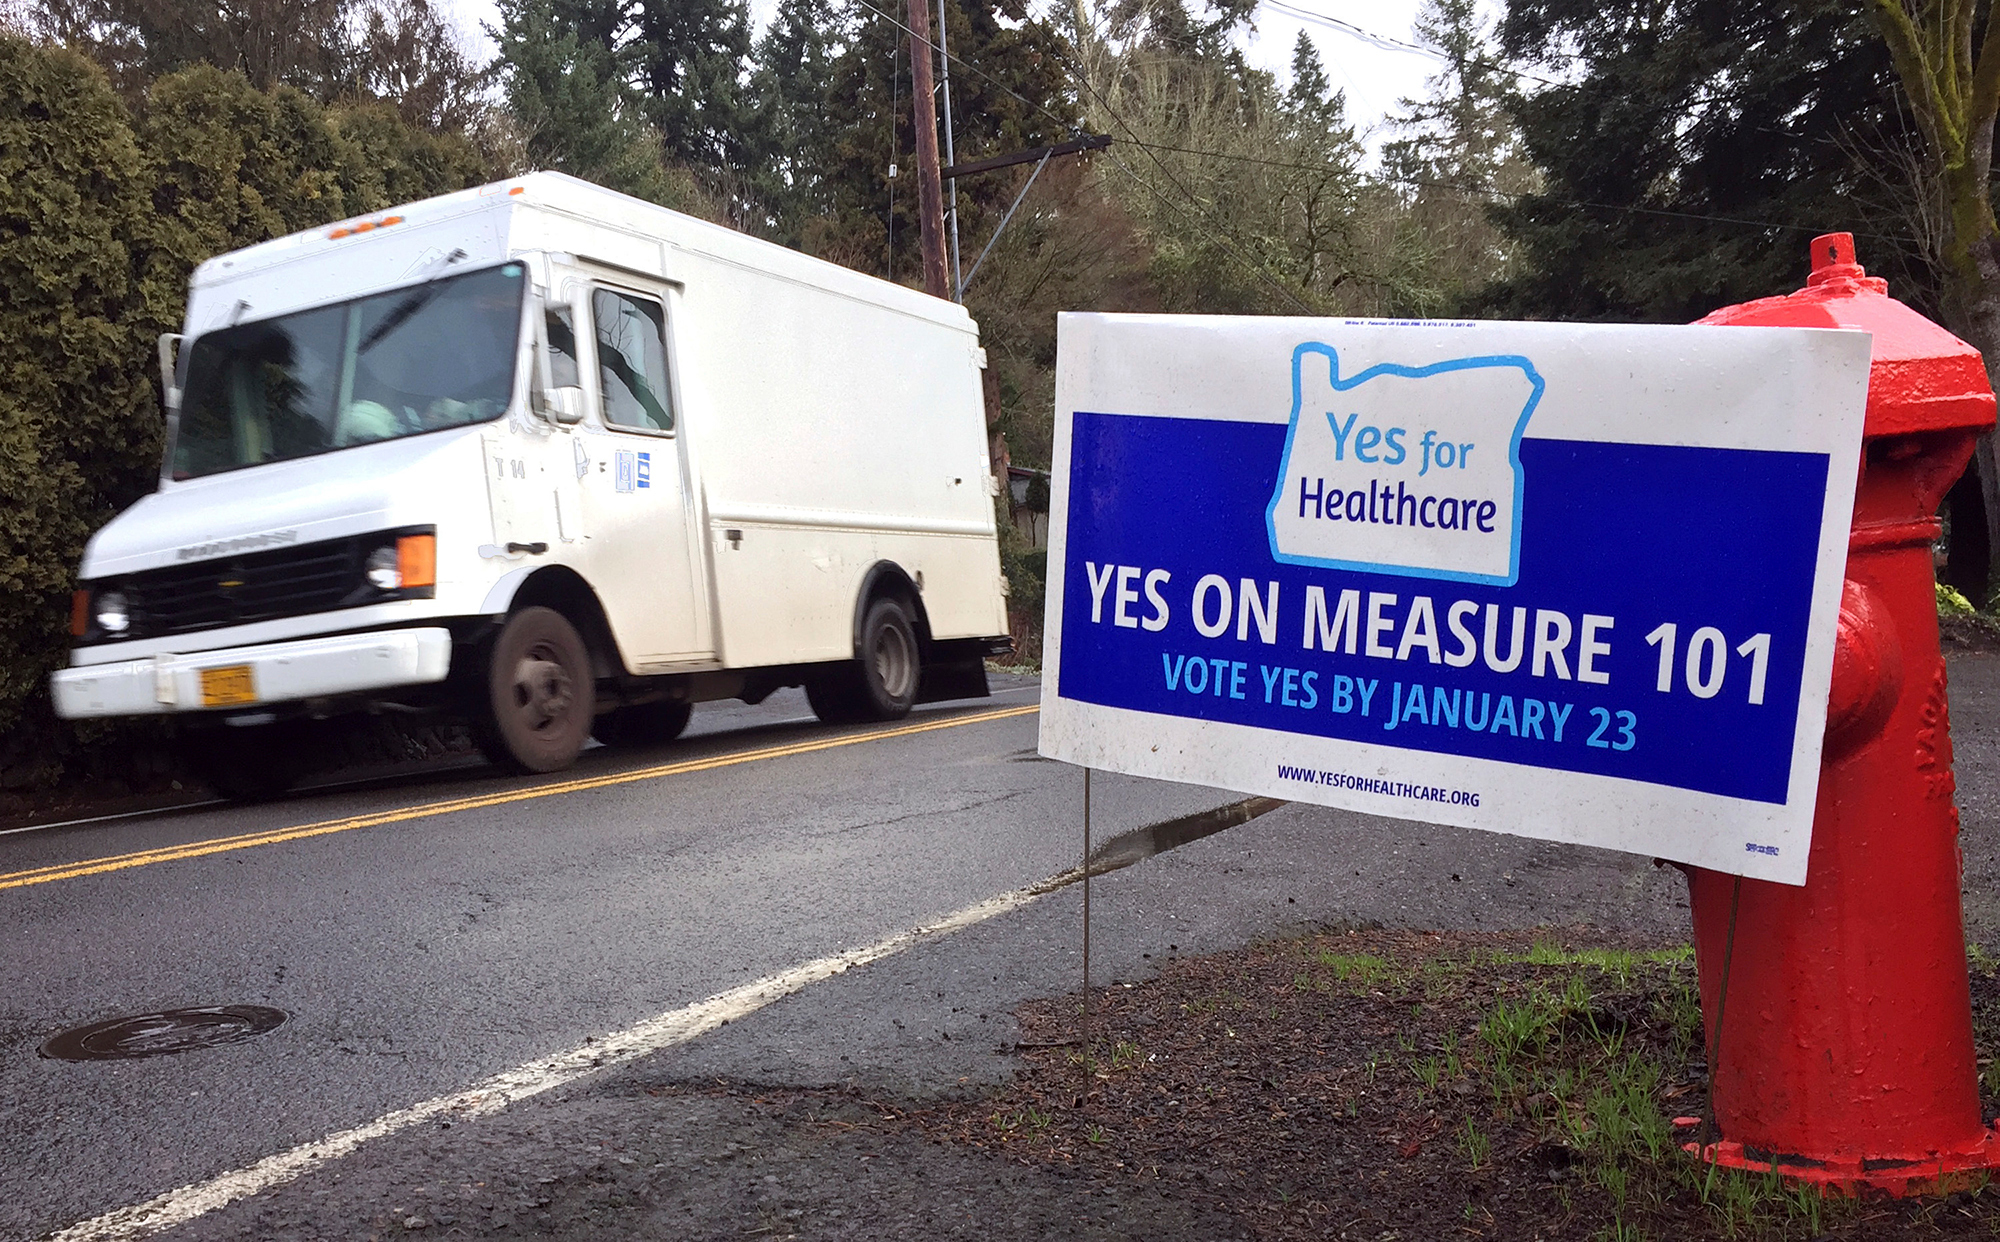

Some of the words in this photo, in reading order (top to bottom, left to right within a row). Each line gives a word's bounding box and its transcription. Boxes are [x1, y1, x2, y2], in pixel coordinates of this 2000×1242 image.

[1326, 411, 1407, 466] Yes
[1418, 429, 1475, 477] for
[1299, 476, 1497, 534] Healthcare
[1085, 561, 1172, 632] YES
[1191, 574, 1280, 645] ON
[1302, 585, 1615, 685] MEASURE
[1644, 622, 1771, 705] 101
[1162, 653, 1248, 700] VOTE
[1261, 664, 1319, 710] YES
[1332, 674, 1379, 717] BY
[1383, 681, 1574, 743] JANUARY
[1586, 706, 1637, 751] 23
[1277, 765, 1480, 807] WWW.YESFORHEALTHCARE.ORG
